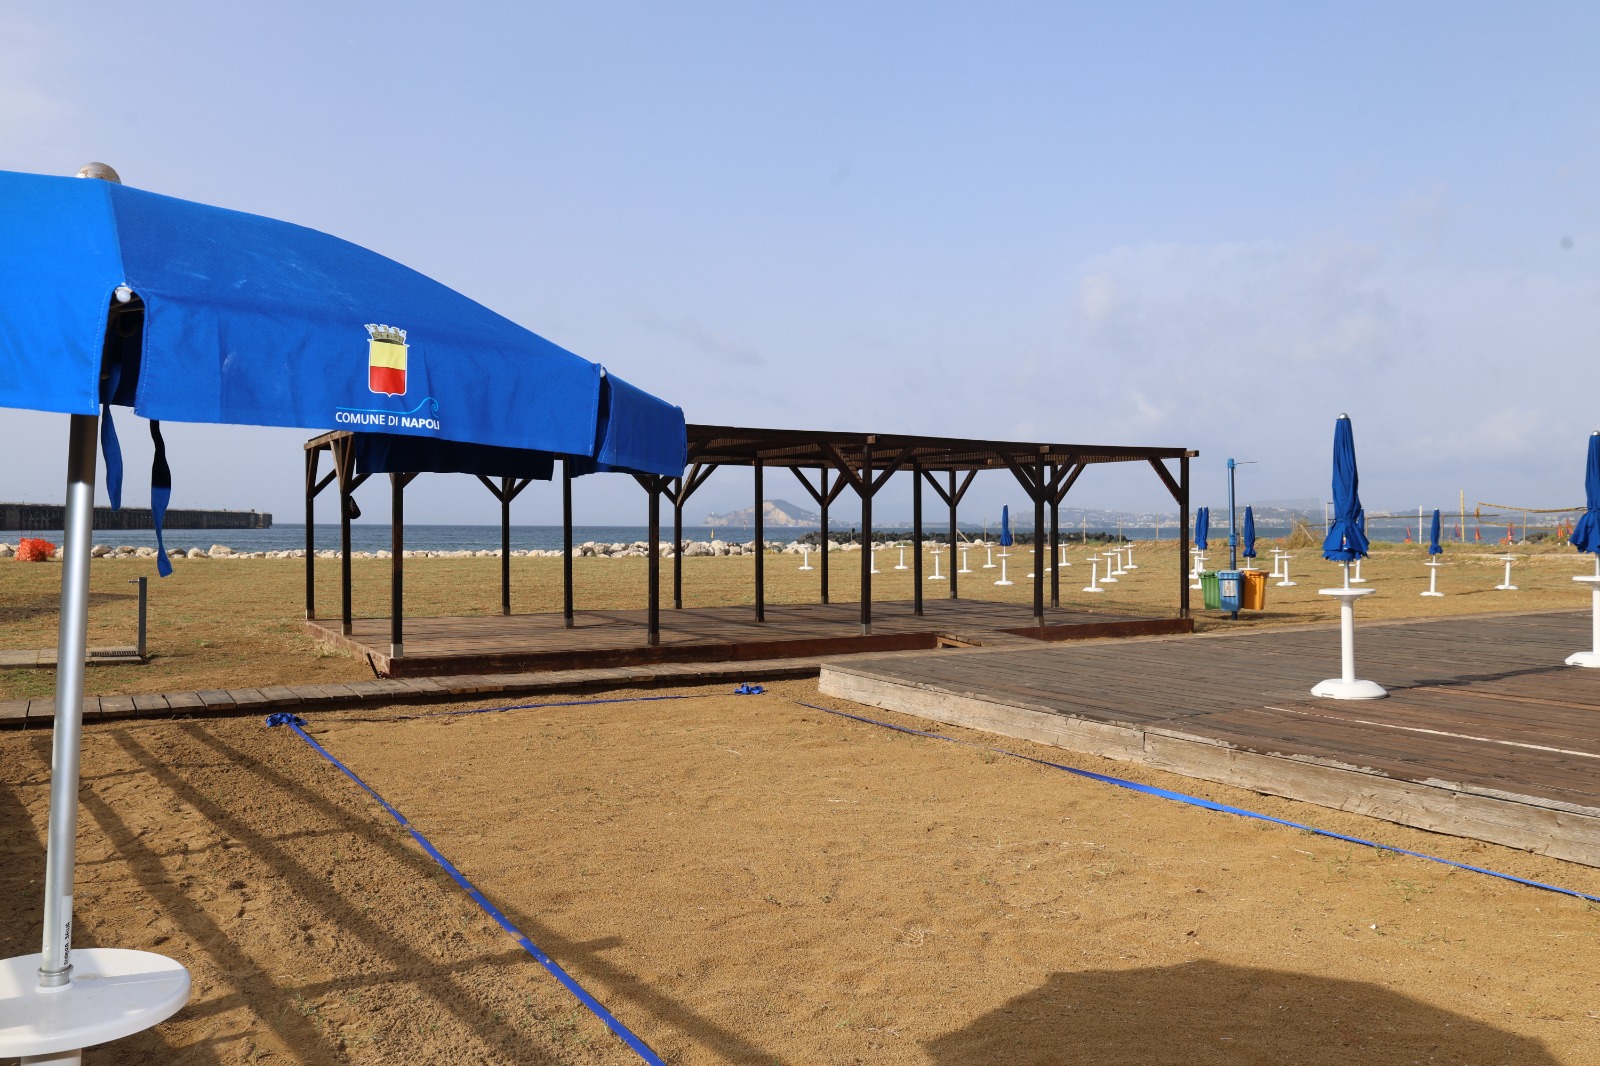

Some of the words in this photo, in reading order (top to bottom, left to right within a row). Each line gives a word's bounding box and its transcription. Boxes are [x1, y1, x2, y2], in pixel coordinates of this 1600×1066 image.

[335, 411, 385, 425] COMUNE
[388, 415, 398, 426] DI
[401, 416, 440, 430] NAPOLI
